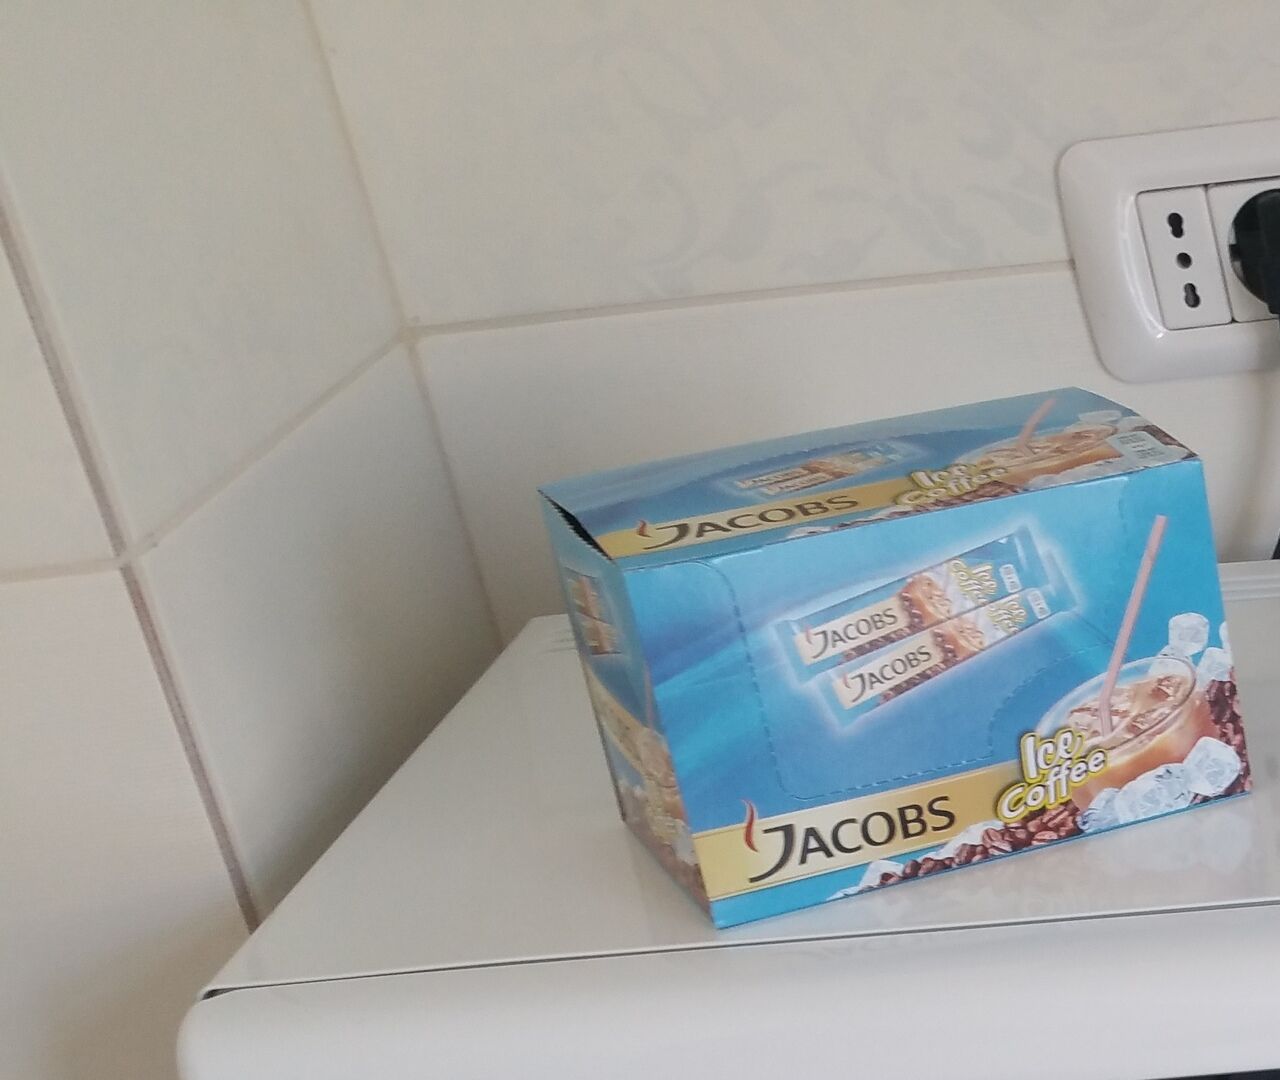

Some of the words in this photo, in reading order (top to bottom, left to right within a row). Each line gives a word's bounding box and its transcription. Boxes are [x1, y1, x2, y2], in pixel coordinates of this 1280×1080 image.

[642, 495, 859, 550] JACOBS
[811, 607, 899, 660] JACOBS
[851, 645, 932, 704] JACOBS
[1022, 731, 1078, 780] Ice
[998, 749, 1107, 820] Coffee
[747, 795, 957, 884] JACOBS
